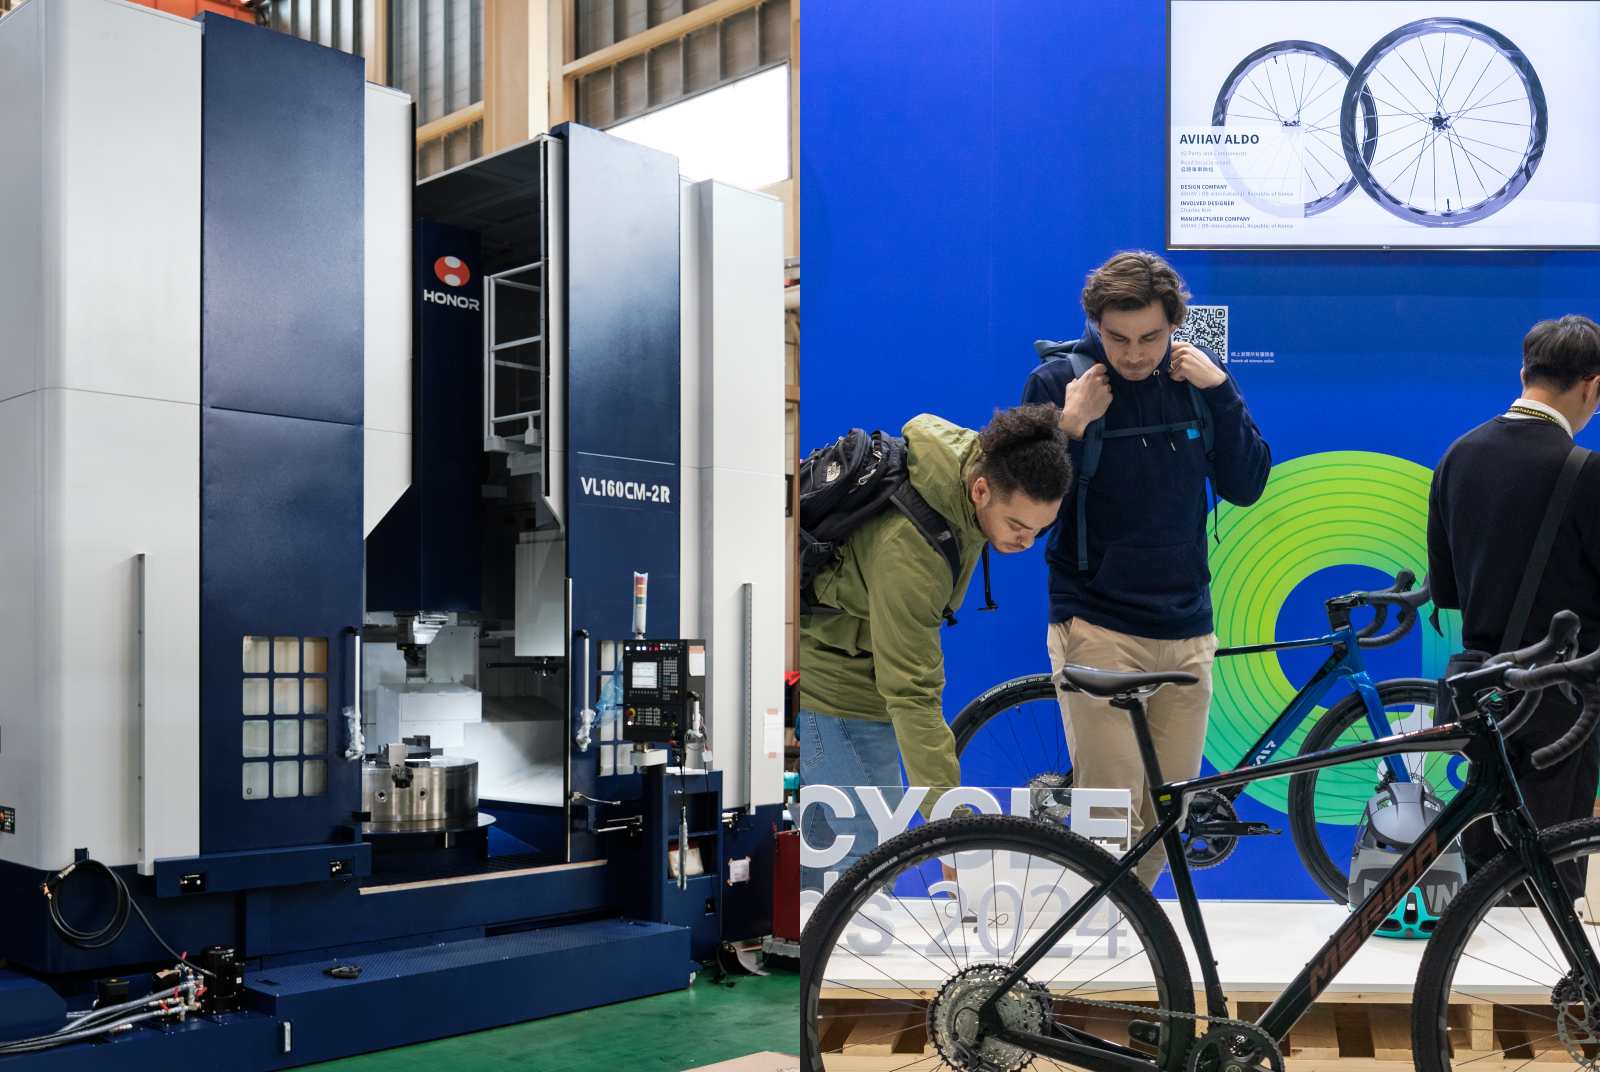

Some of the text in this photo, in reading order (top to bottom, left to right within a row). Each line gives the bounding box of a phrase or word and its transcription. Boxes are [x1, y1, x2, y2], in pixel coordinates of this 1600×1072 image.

[1179, 134, 1260, 144] AVIIAV ALDO
[423, 289, 480, 311] HONOR
[580, 476, 671, 504] VL160CM-2R
[800, 784, 1132, 870] CYCLE
[925, 881, 1128, 958] 2024
[1310, 829, 1439, 999] MERIDA
